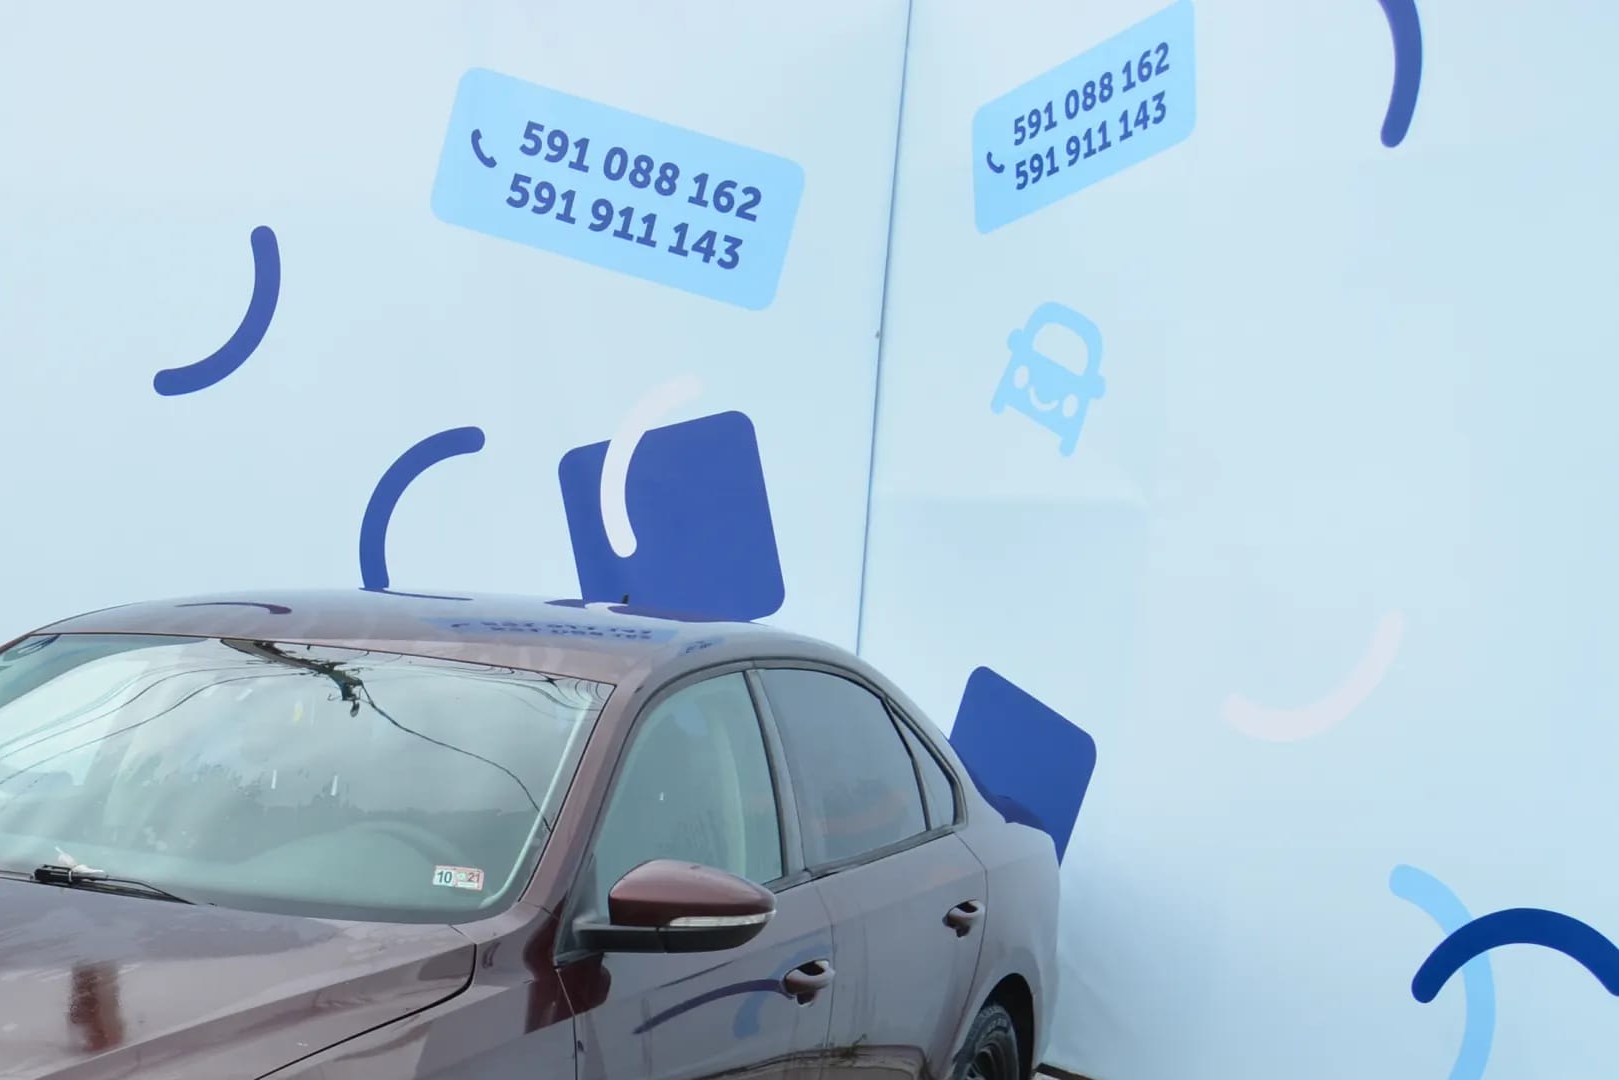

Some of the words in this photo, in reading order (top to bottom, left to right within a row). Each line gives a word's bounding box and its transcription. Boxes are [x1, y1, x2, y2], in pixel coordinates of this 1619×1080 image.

[1013, 101, 1058, 146] 591
[1064, 71, 1114, 121] 088
[1121, 41, 1170, 93] 162
[1015, 146, 1060, 191] 591
[1065, 120, 1112, 167] 911
[1118, 90, 1167, 142] 143
[505, 172, 577, 225] 591
[588, 198, 658, 248] 911
[667, 222, 743, 270] 143
[519, 119, 591, 173] 591
[603, 146, 680, 197] 088
[687, 172, 762, 222] 162
[437, 870, 453, 884] 10
